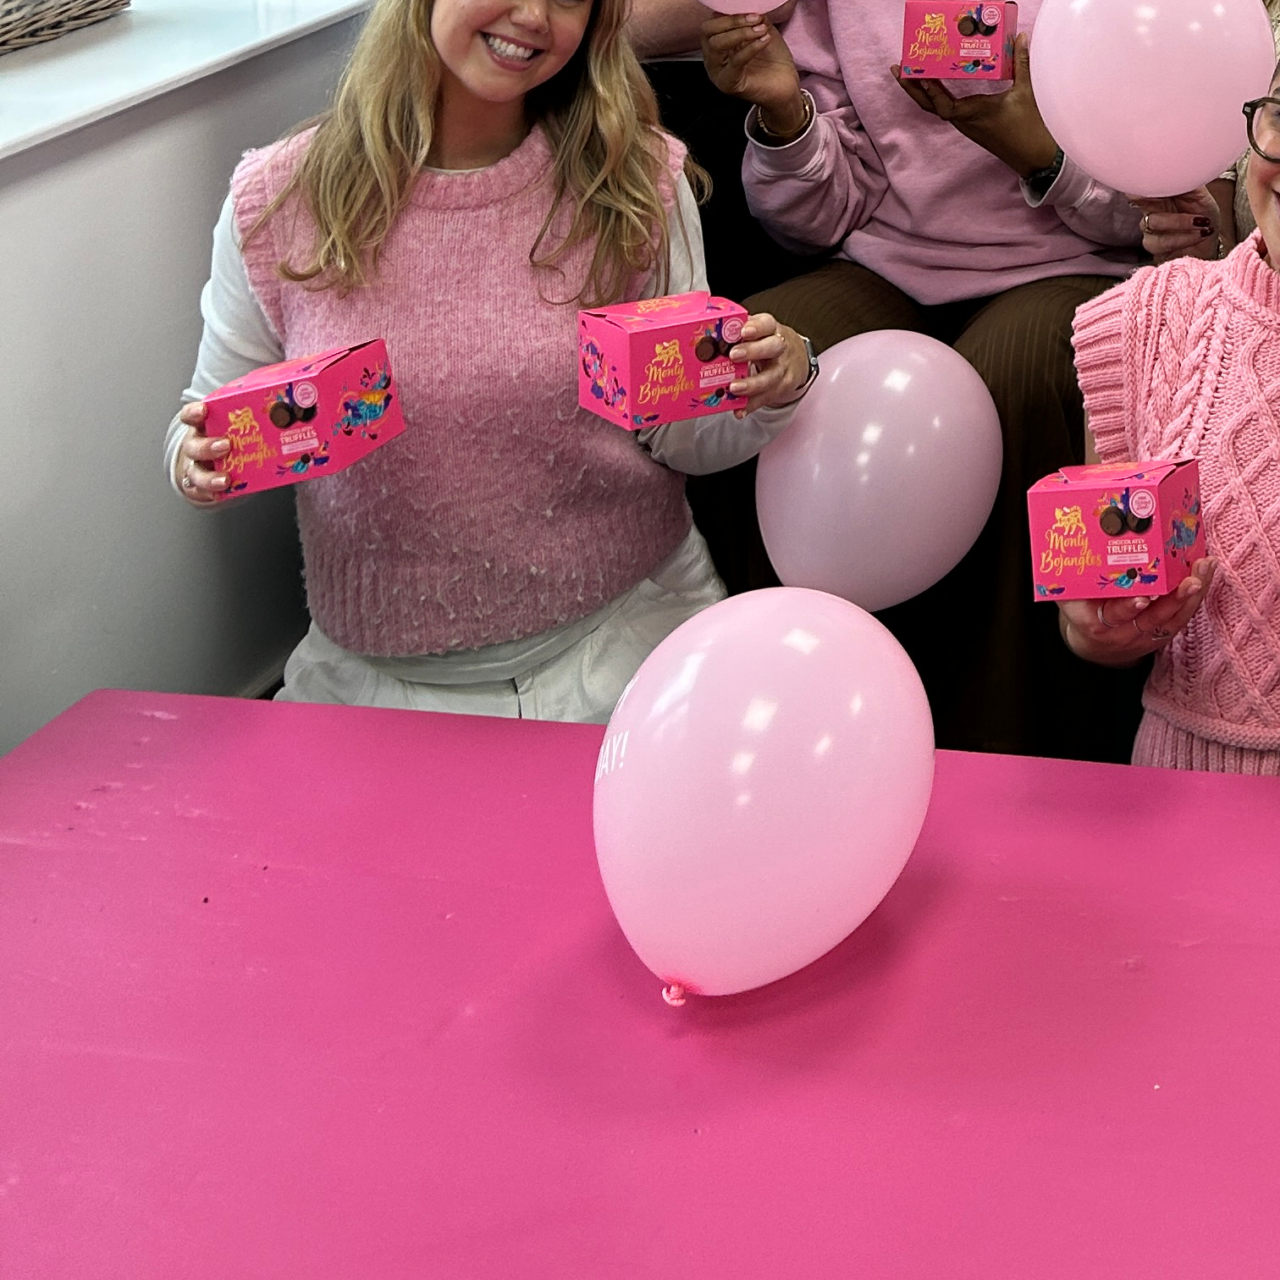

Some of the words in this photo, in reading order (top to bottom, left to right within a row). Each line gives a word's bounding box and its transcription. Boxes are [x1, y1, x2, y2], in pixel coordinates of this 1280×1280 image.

[645, 363, 685, 383] Monty
[700, 365, 736, 378] TRUFFLES
[638, 379, 695, 405] Bojangles
[280, 430, 317, 444] TRUFFLES
[1045, 529, 1089, 555] Monty
[1107, 543, 1148, 554] TRUFFLES
[1040, 550, 1102, 576] Bojangles
